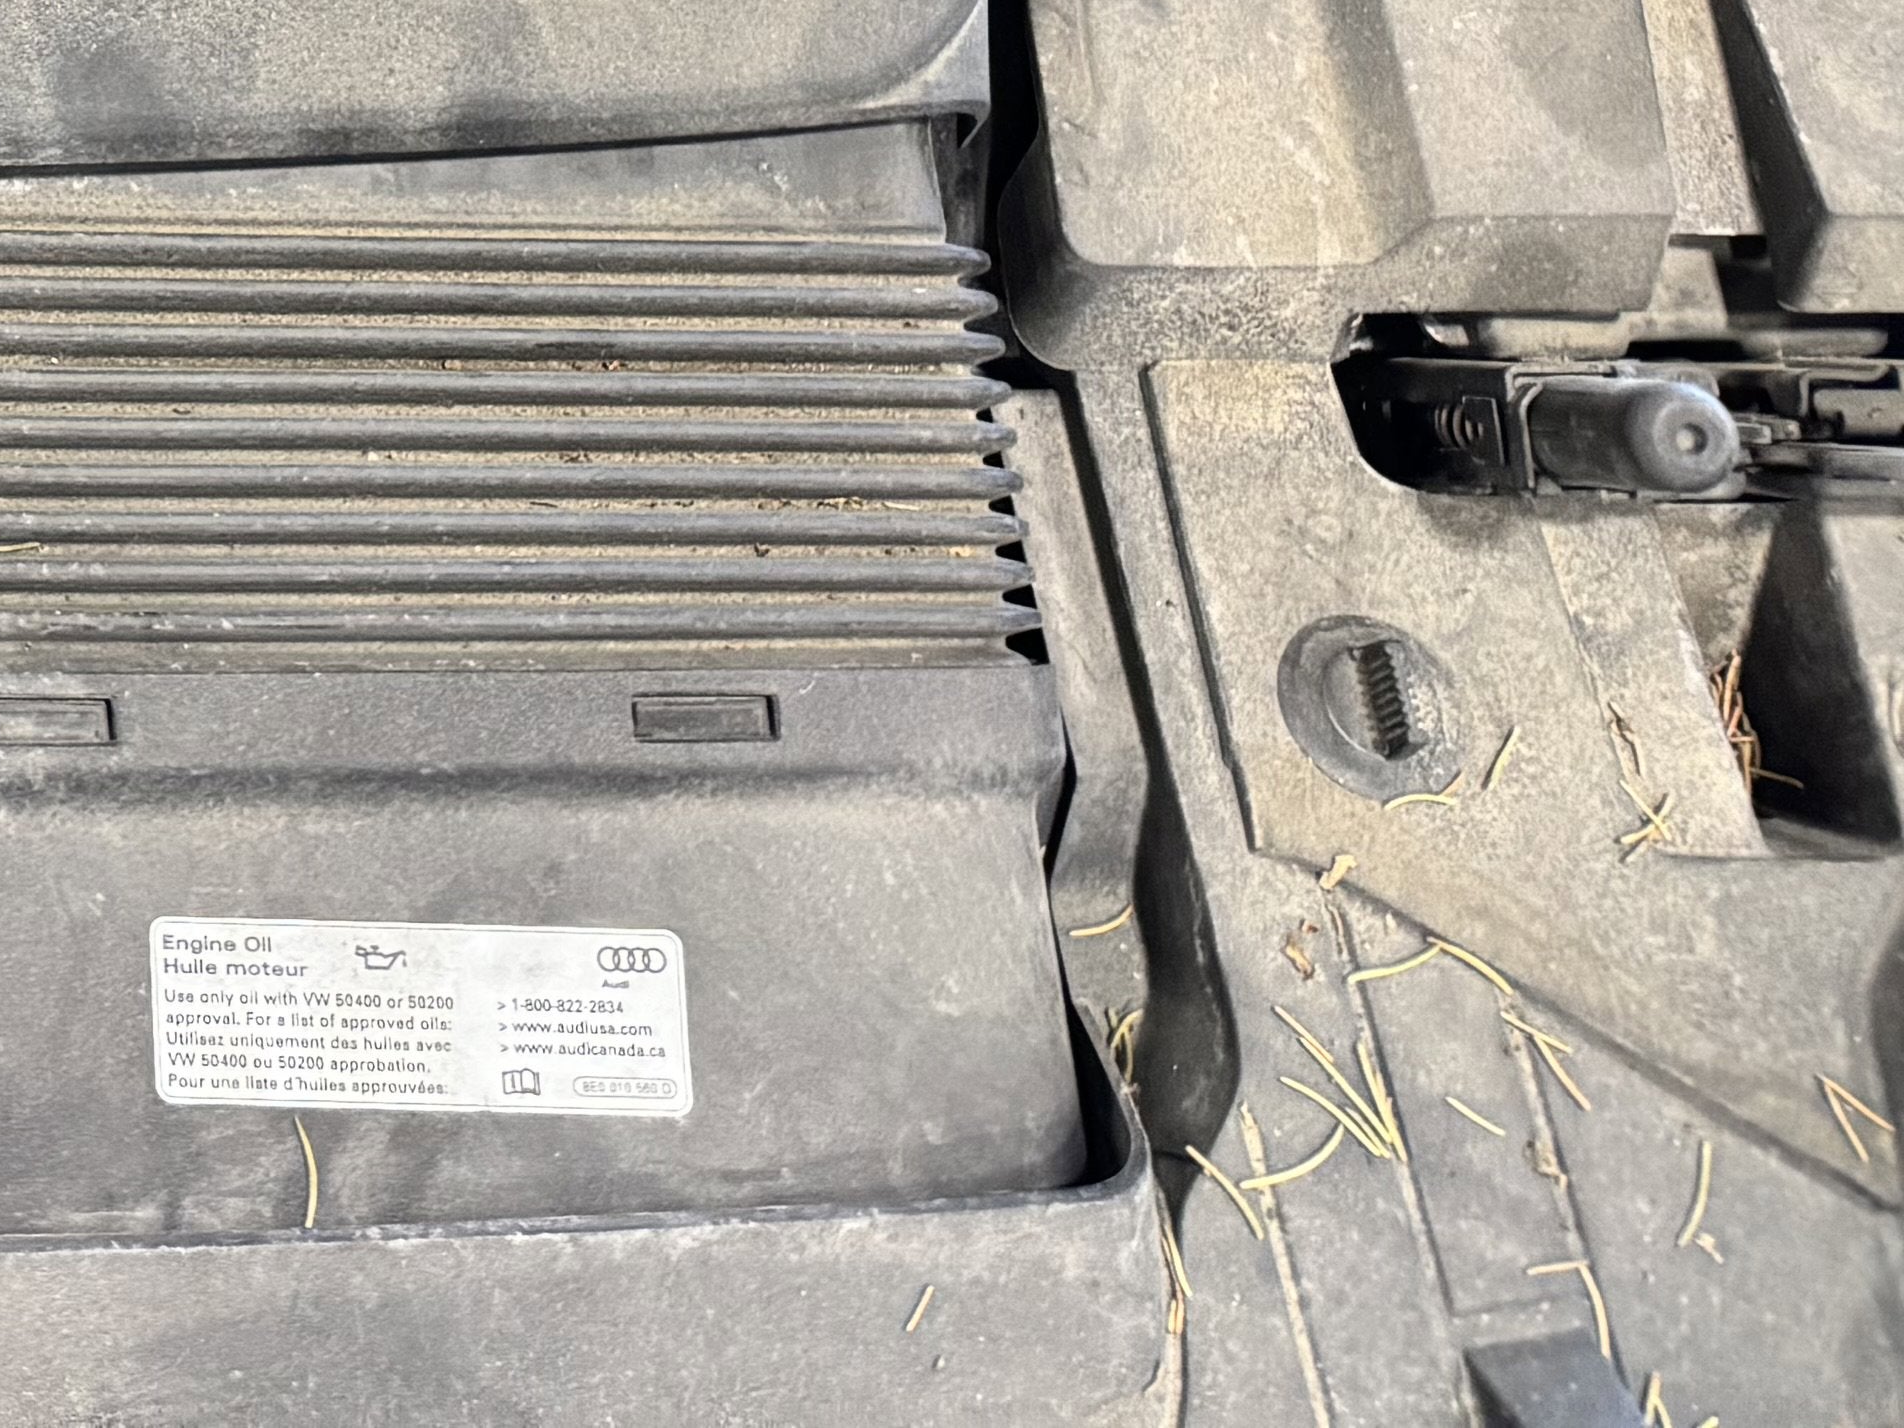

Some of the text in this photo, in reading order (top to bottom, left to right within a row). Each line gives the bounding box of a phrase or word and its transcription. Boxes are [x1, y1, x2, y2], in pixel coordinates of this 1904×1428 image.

[162, 934, 272, 955] Engine Oil
[163, 957, 309, 976] Huile moteur
[164, 988, 454, 1010] Use only oil with VW 50400 or 50200
[511, 998, 624, 1014] 1-800-822-2834
[166, 1011, 453, 1032] approval. For a list of approved oils:
[511, 1021, 653, 1037] www.audiusa.com
[166, 1031, 452, 1052] Utilisez uniquement des huiles avec
[513, 1042, 666, 1058] www.audicanada.ca
[168, 1052, 431, 1074] VW 50400 ou 50200 approbation.
[168, 1073, 448, 1096] Pour une liste d'huiles approuvées:
